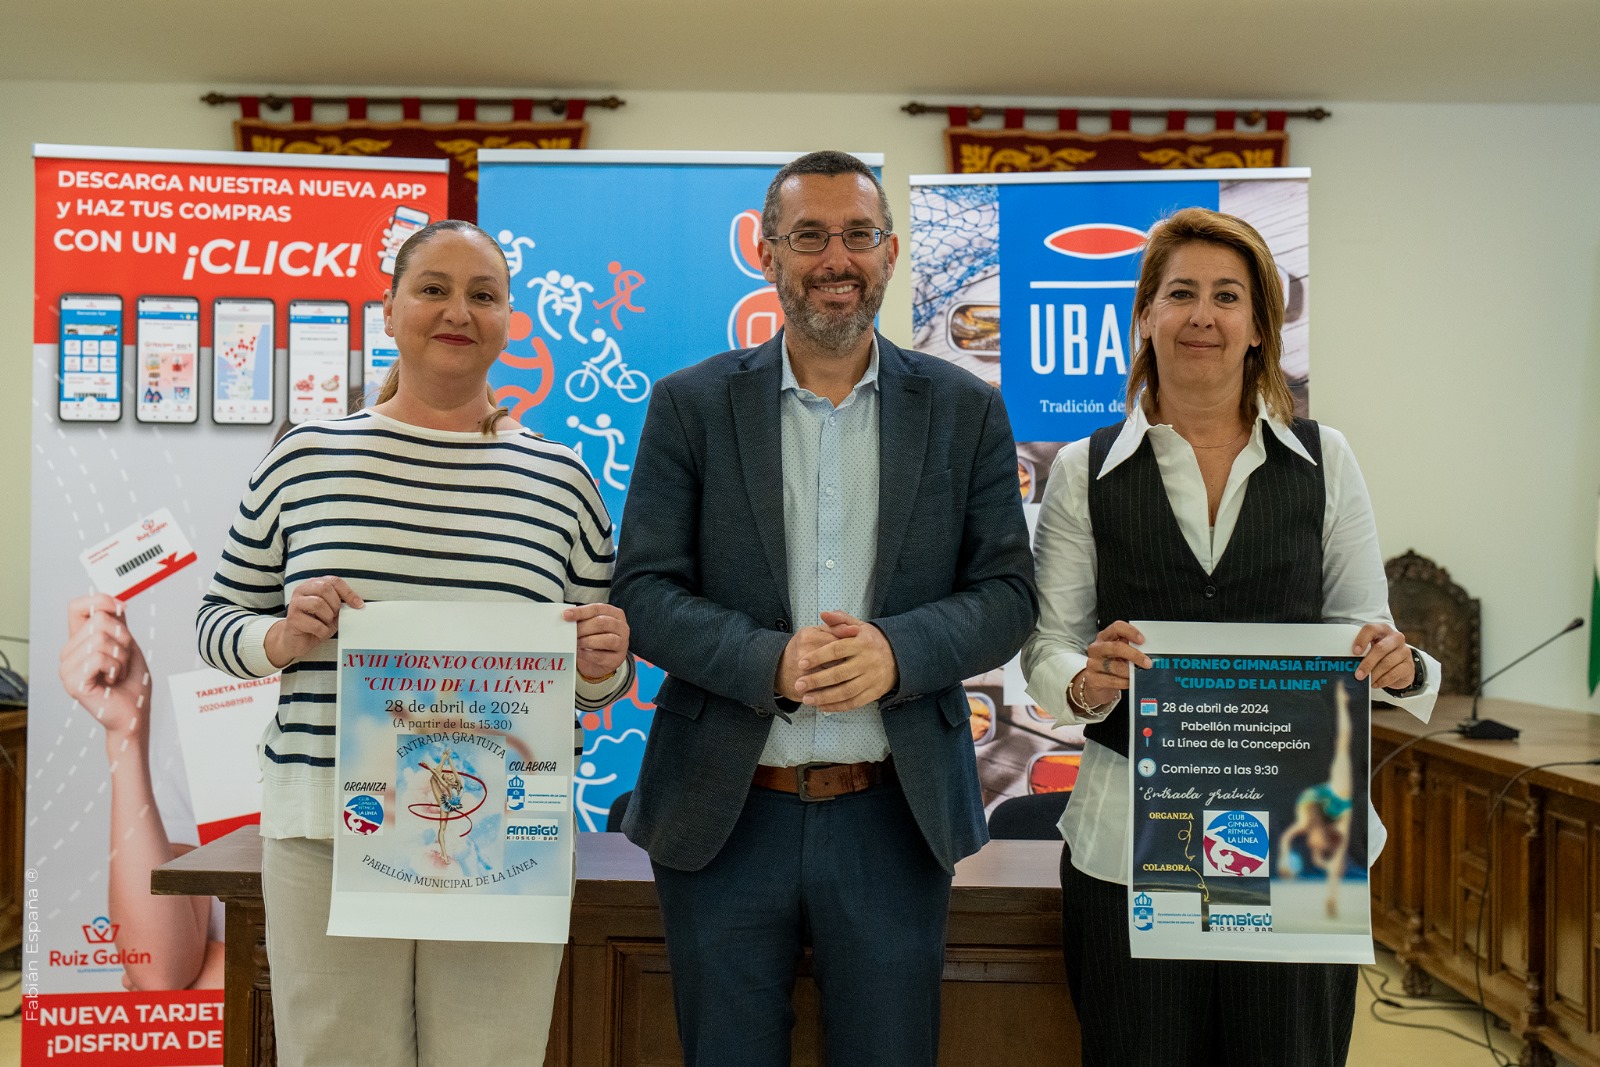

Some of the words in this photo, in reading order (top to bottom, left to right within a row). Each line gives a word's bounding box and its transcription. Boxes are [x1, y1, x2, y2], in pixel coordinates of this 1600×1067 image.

[58, 170, 183, 192] DESCARGA
[189, 174, 293, 196] NUESTRA
[299, 179, 376, 199] NUEVA
[380, 183, 427, 200] APP
[56, 202, 70, 219] y
[76, 200, 125, 217] HAZ
[130, 200, 174, 219] TUS
[178, 202, 292, 222] COMPRAS
[53, 229, 122, 253] CON
[132, 231, 177, 254] UN
[183, 238, 362, 280] ¡CLICK!
[1030, 303, 1127, 375] UBA
[1040, 400, 1105, 413] Tradición
[343, 653, 388, 669] XVIII
[393, 652, 467, 671] TORNEO
[471, 656, 567, 672] COMARCAL
[1172, 658, 1231, 670] TORNEO
[1233, 659, 1303, 671] GIMNASIA
[196, 685, 235, 698] TARJETA
[364, 676, 436, 692] "CIUDAD
[440, 678, 466, 693] DE
[468, 679, 489, 693] LA
[494, 676, 554, 694] LÍNEA"
[1175, 677, 1236, 690] "CIUDAD
[1238, 678, 1258, 690] DE
[1260, 678, 1277, 690] LA
[1279, 679, 1327, 691] LINEA"
[385, 699, 403, 713] 28
[408, 700, 425, 713] de
[430, 700, 465, 714] abril
[469, 701, 486, 714] de
[490, 701, 529, 715] 2024
[1162, 702, 1177, 713] 28
[1178, 702, 1194, 713] de
[1196, 702, 1221, 714] abril
[1224, 703, 1239, 714] de
[1241, 703, 1269, 714] 2024
[392, 718, 405, 729] (A
[408, 719, 442, 731] partir
[443, 719, 457, 730] de
[459, 719, 475, 730] las
[478, 719, 512, 731] 15:30)
[1181, 721, 1231, 732] Pabellón
[1233, 722, 1291, 735] municipal
[396, 732, 450, 758] ENTRADA
[452, 731, 506, 759] GRATUITA
[1162, 738, 1176, 748] La
[1177, 737, 1208, 748] Línea
[1209, 738, 1226, 749] de
[1227, 738, 1239, 749] la
[1240, 739, 1310, 752] Concepción
[509, 761, 557, 772] COLABORA
[1161, 764, 1221, 775] Comienzo
[1223, 767, 1232, 775] a
[1234, 764, 1252, 775] las
[1254, 764, 1279, 776] 9:30
[344, 781, 387, 792] ORGANIZA
[1205, 787, 1264, 806] gratuita
[1149, 812, 1194, 820] ORGANIZA
[1237, 836, 1259, 844] LÍNEA
[362, 854, 413, 883] PABELLÓN
[414, 875, 474, 888] MUNICIPAL
[475, 875, 490, 887] DE
[492, 872, 507, 883] LA
[507, 858, 538, 878] LÍNEA
[1142, 864, 1191, 872] COLABORA
[49, 950, 89, 966] Ruiz
[93, 948, 151, 965] Galán
[40, 1005, 130, 1026] NUEVA
[135, 1003, 225, 1022] TARJET
[47, 1032, 181, 1057] ¡DISFRUTA
[188, 1030, 222, 1048] DE
